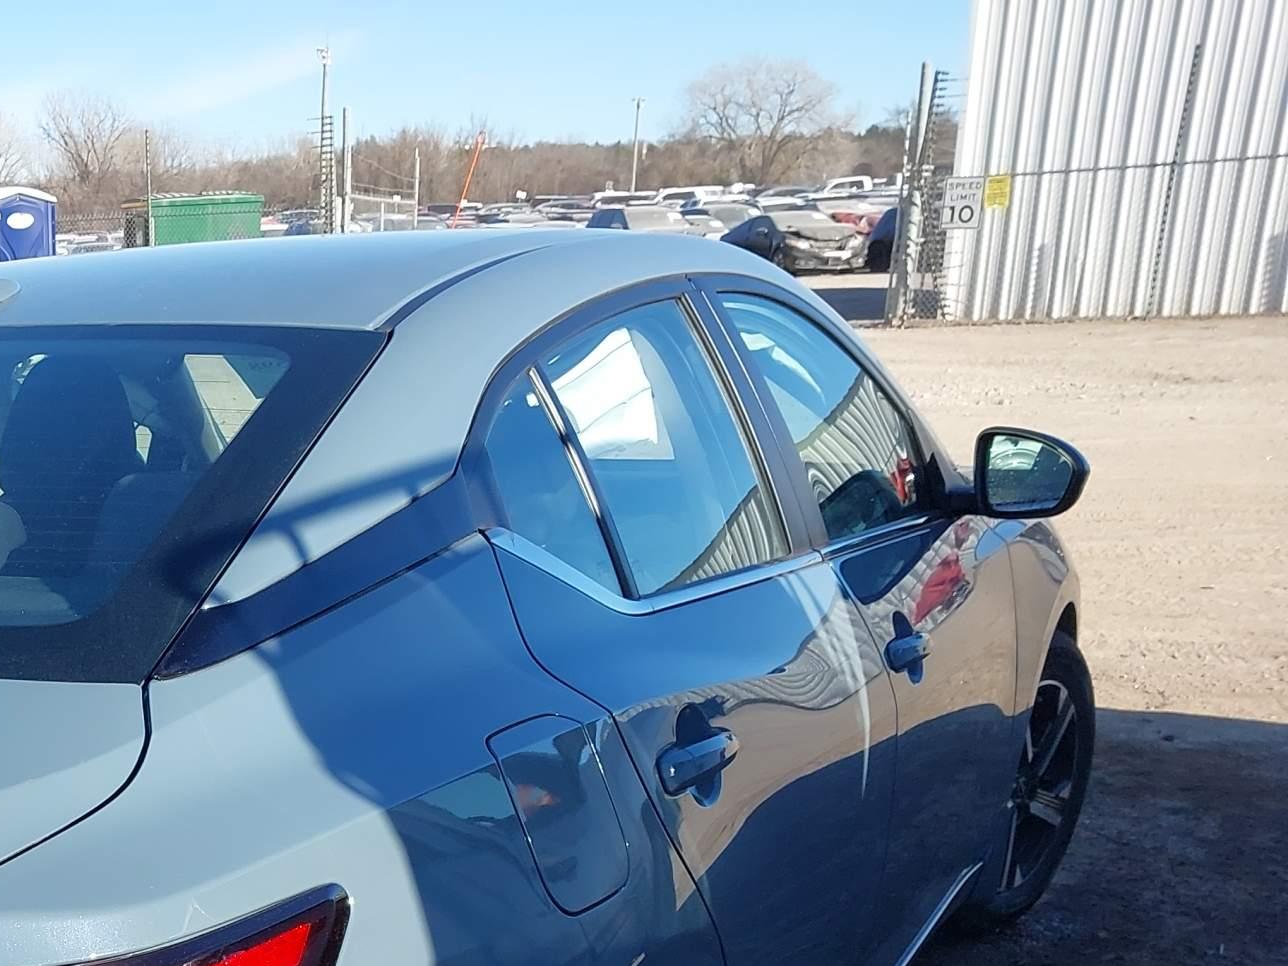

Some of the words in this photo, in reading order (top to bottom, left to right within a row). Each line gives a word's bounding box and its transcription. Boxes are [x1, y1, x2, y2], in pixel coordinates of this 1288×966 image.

[948, 181, 982, 191] SPEED
[950, 193, 976, 201] LIMIT
[949, 204, 974, 223] 10
